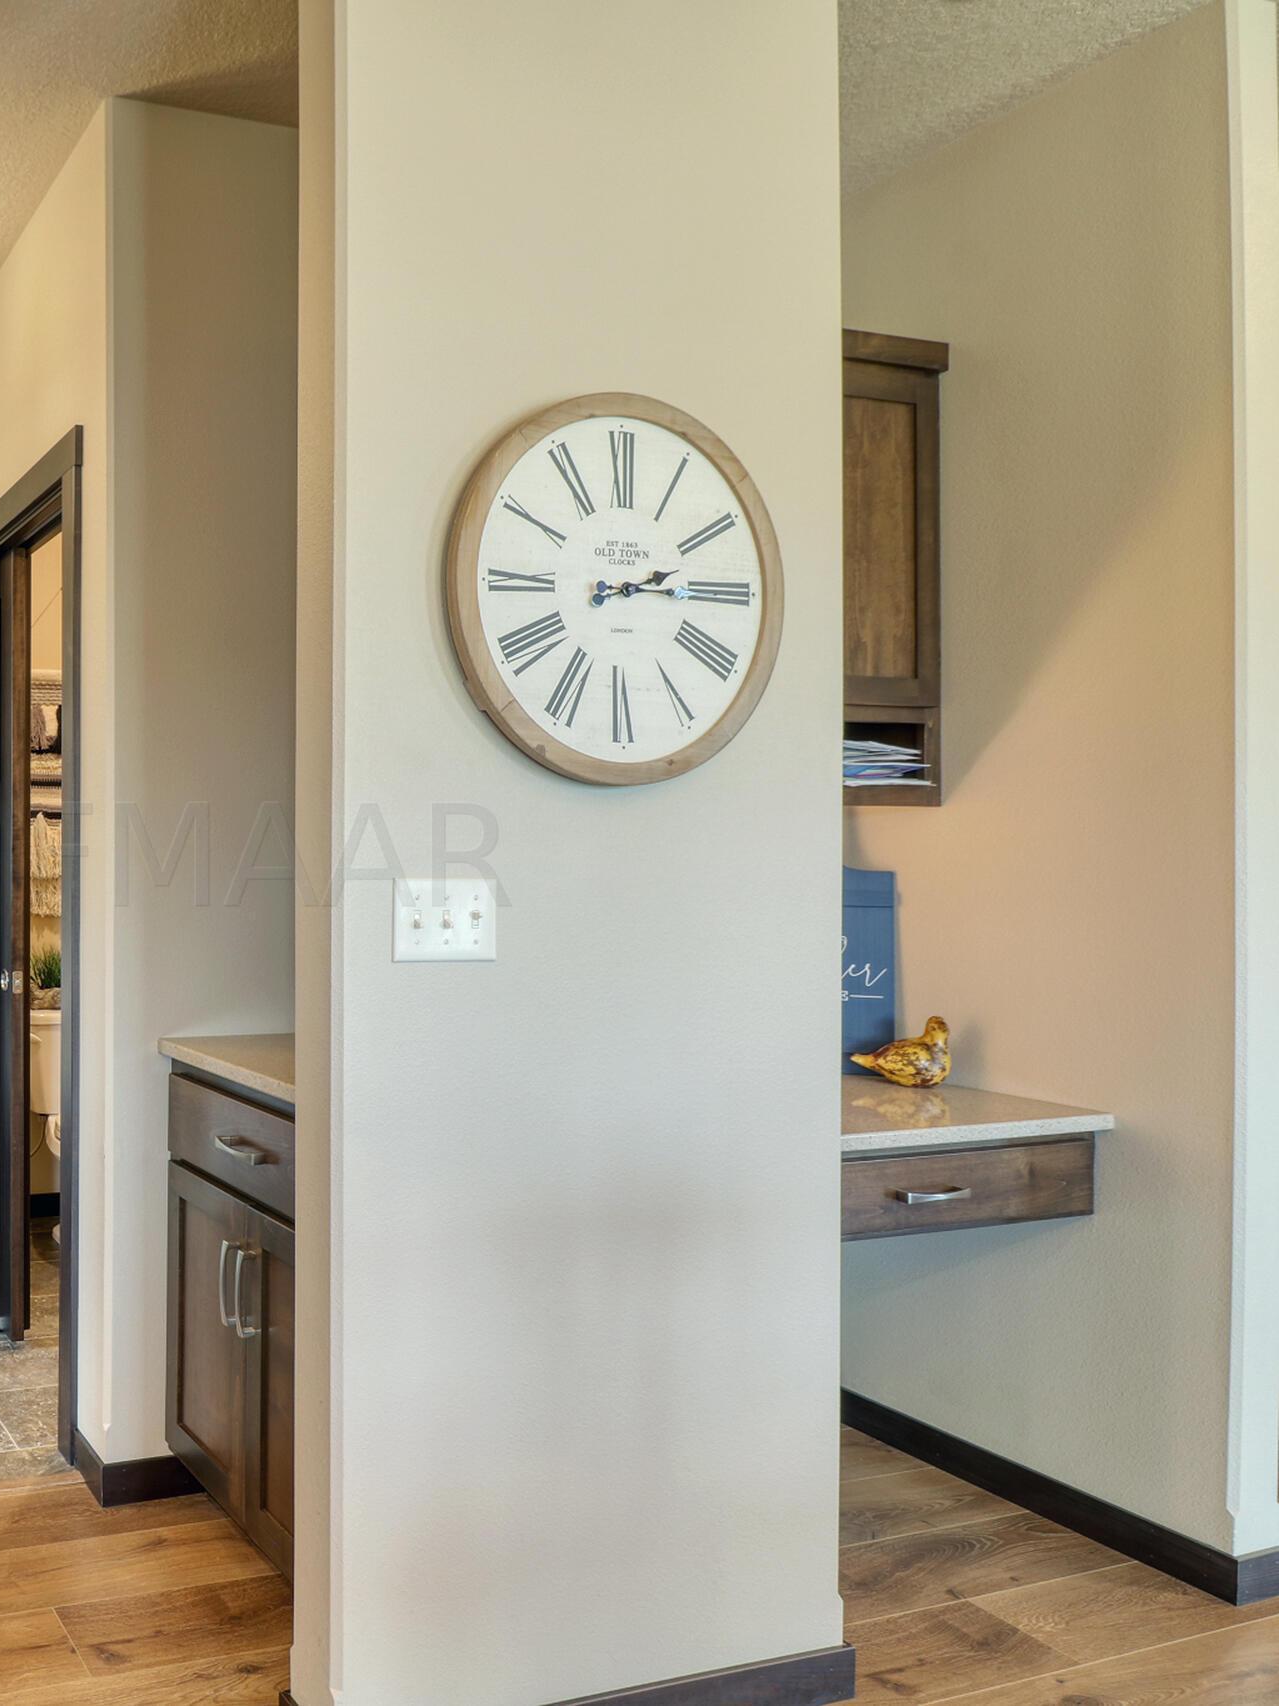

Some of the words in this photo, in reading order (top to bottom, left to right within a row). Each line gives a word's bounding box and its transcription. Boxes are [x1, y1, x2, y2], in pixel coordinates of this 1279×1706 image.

[606, 540, 619, 548] EST
[594, 547, 616, 557] OLD
[618, 548, 650, 559] TOWN
[608, 558, 636, 566] CLOCKS
